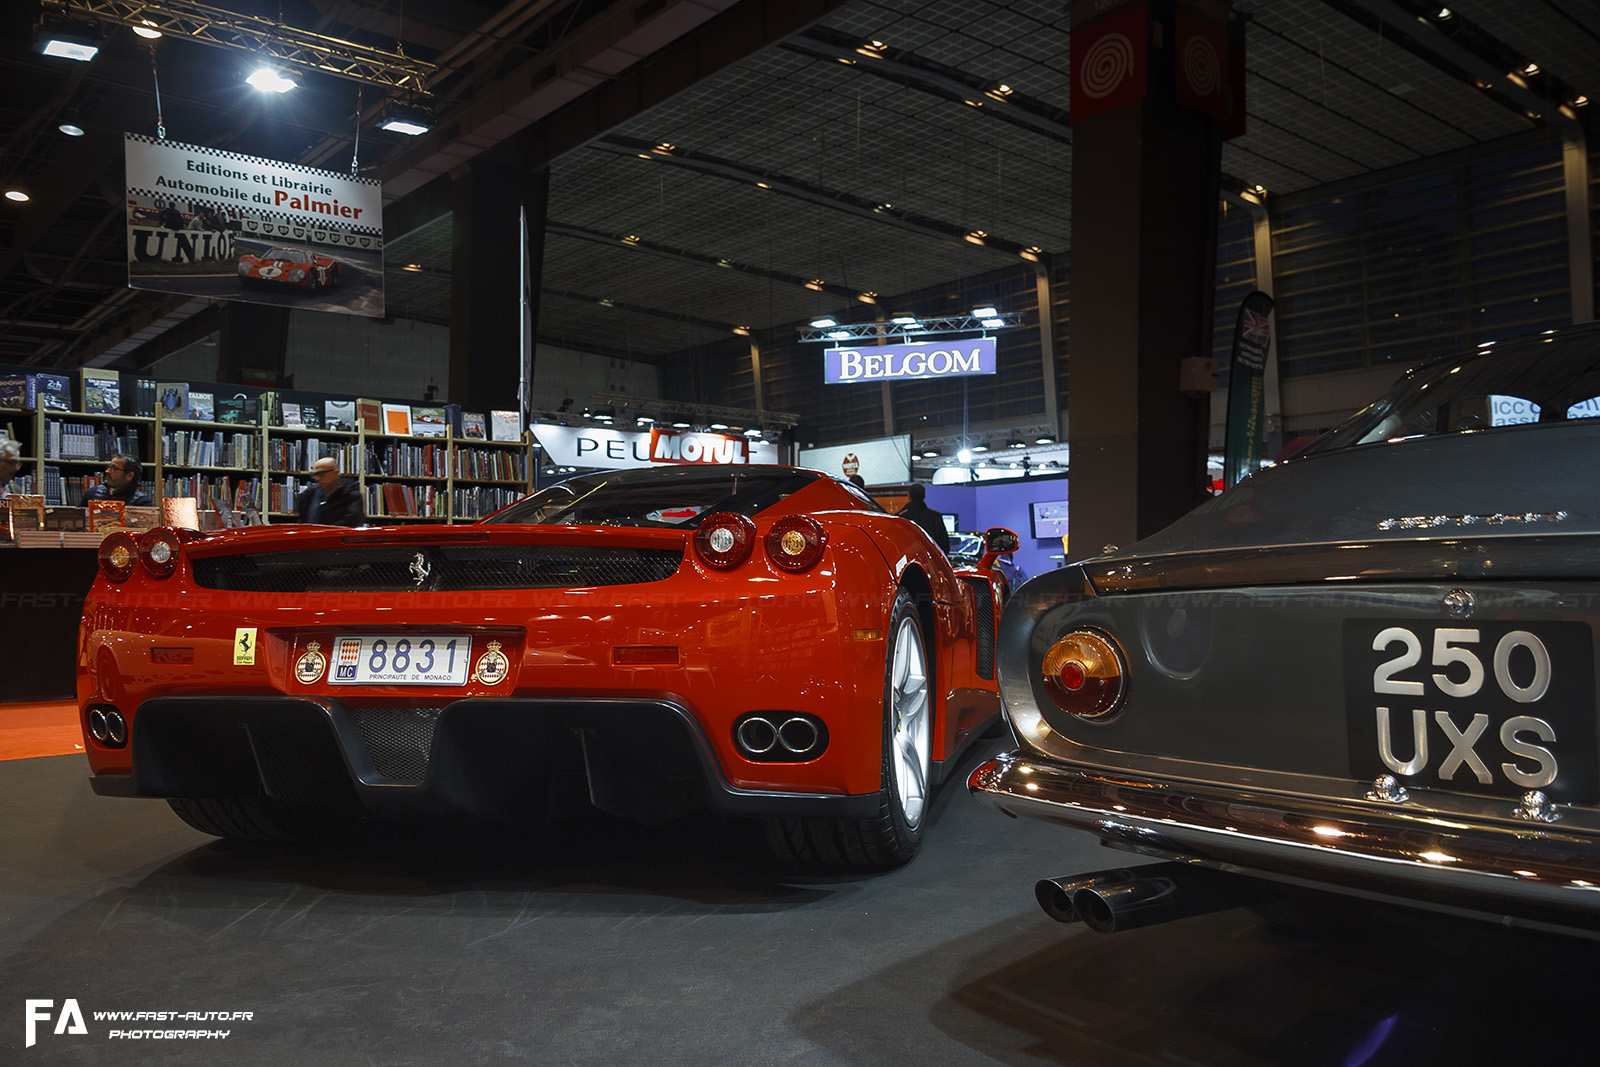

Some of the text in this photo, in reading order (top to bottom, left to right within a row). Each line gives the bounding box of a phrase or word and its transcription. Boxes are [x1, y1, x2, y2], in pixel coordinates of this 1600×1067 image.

[186, 159, 333, 196] Editions et Librairie
[155, 175, 248, 201] Automobile
[252, 191, 271, 205] du
[274, 189, 363, 220] Palmier
[838, 348, 982, 380] BELGOM
[1494, 401, 1525, 415] ICC
[654, 434, 746, 465] MOTUL
[339, 666, 354, 677] MC
[369, 638, 457, 673] 8831
[1371, 626, 1552, 703] 250
[1375, 706, 1559, 788] UXS
